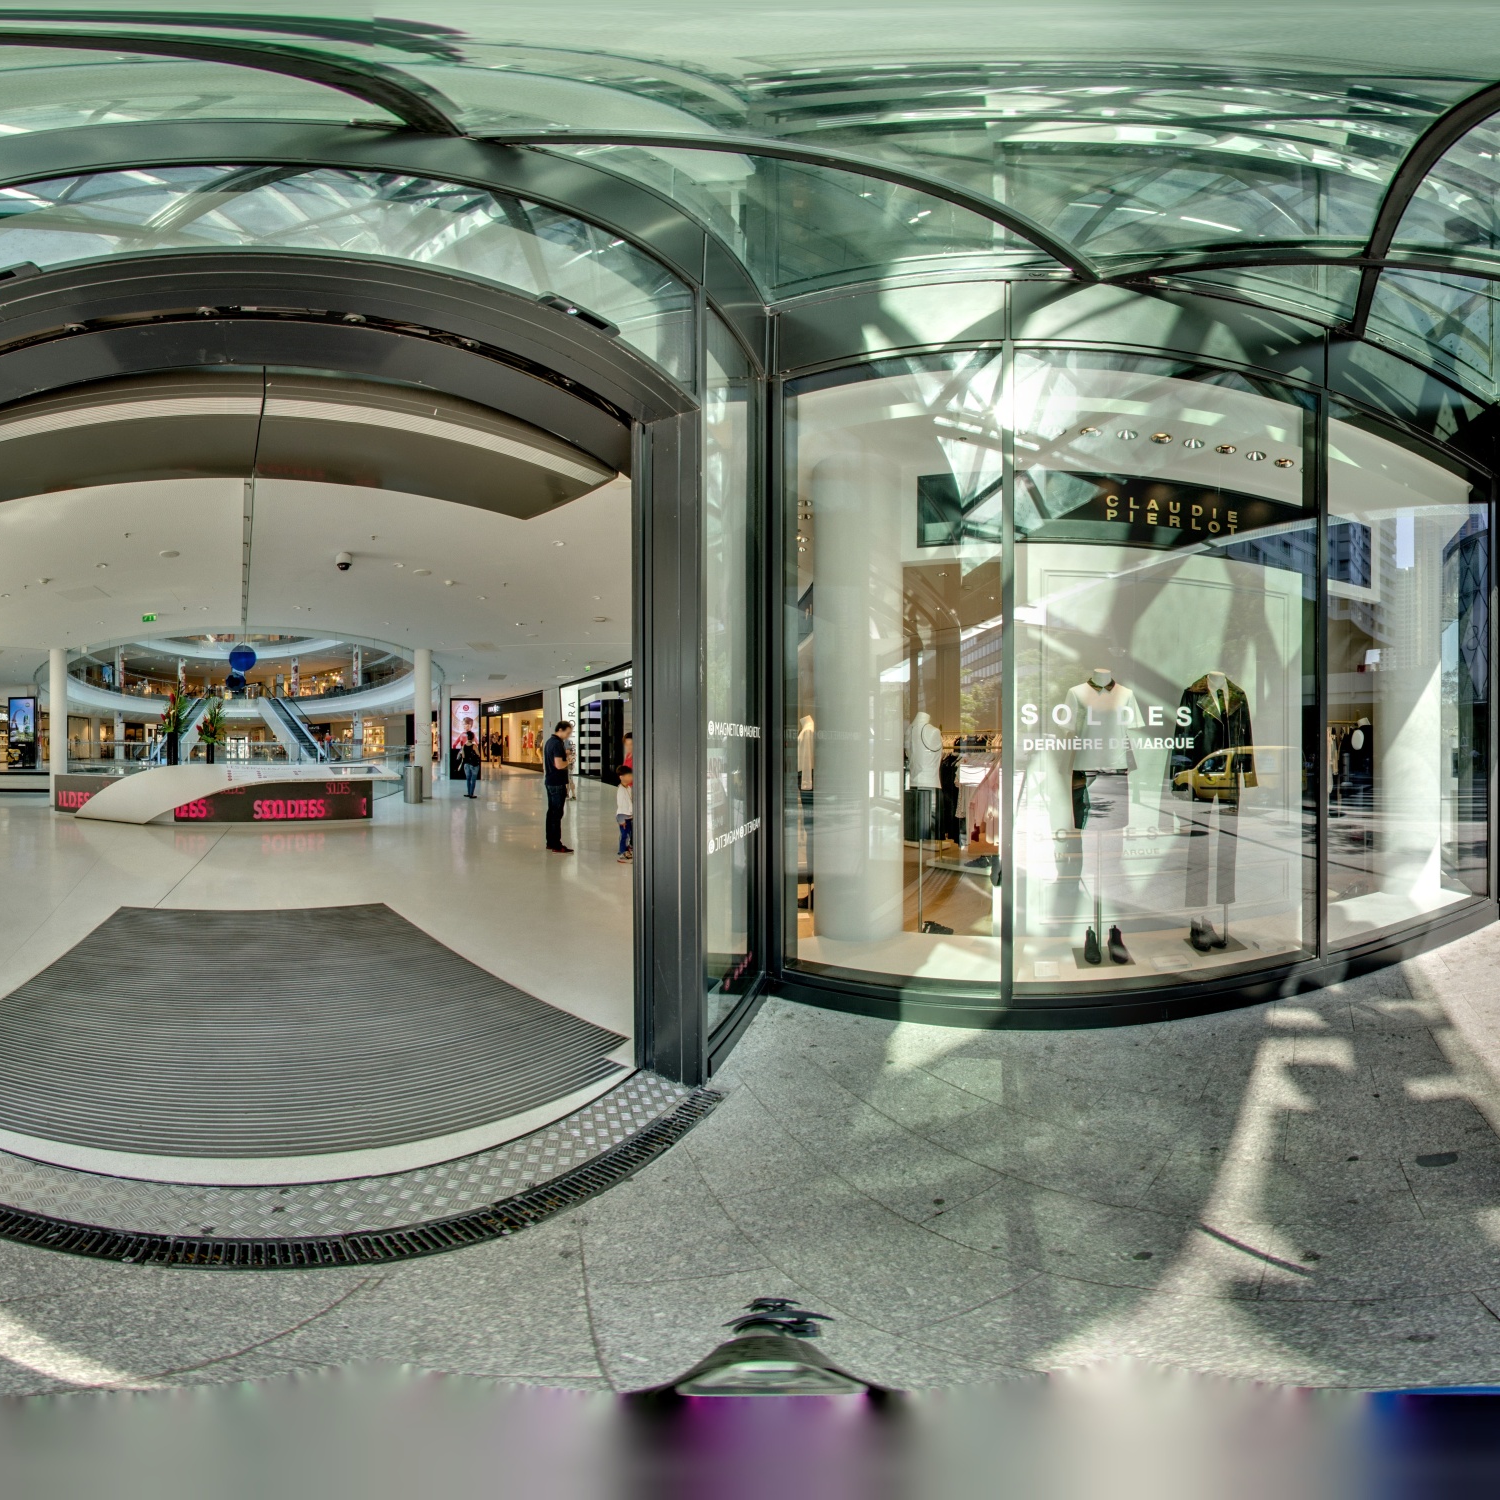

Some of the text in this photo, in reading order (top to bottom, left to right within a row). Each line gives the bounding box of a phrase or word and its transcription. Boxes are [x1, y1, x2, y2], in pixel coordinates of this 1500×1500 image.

[1106, 495, 1238, 522] CLAUDIE
[1106, 509, 1238, 535] PIERLOT
[1020, 703, 1192, 727] SOLDES
[714, 722, 761, 739] MAGNETIC MAGNETIC
[1023, 736, 1195, 751] DERNIÈRE DÉMARQUE
[326, 782, 350, 794] SOLDES
